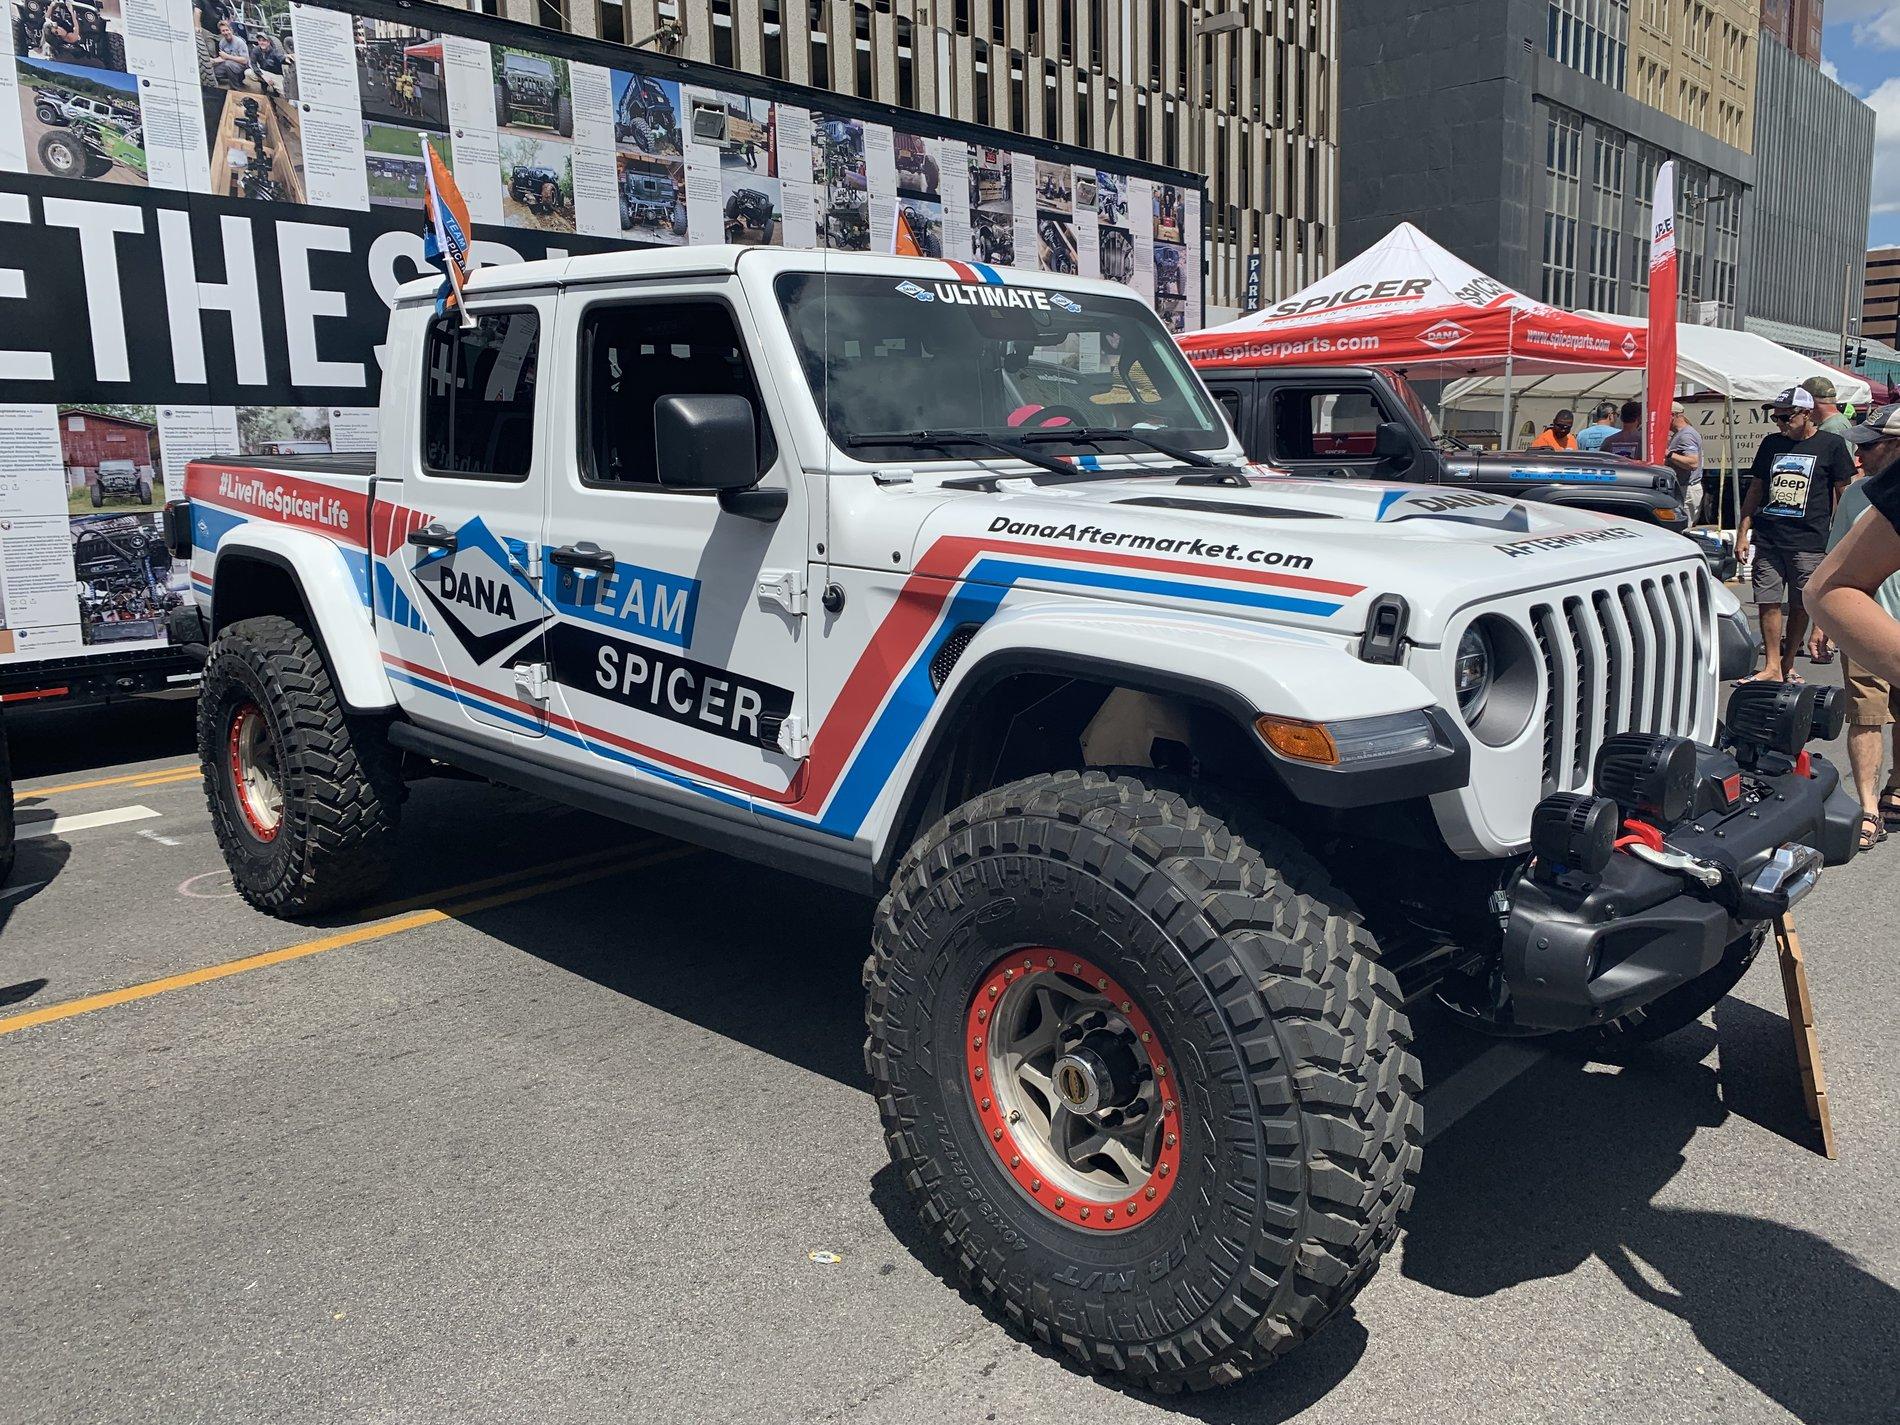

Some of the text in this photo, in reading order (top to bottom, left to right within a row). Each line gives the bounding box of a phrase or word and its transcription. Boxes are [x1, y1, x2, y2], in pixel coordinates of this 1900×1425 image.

[446, 217, 466, 247] TEAM
[934, 283, 1052, 310] ULTIMATE
[1247, 259, 1260, 310] PARK
[1269, 278, 1433, 319] SPICER
[1184, 334, 1380, 362] ww.spicerparts.com
[1427, 330, 1460, 341] DANA
[1527, 329, 1611, 351] www.spicerparts.com
[1700, 409, 1715, 426] Z
[1773, 475, 1806, 490] Jeep
[1774, 489, 1797, 502] fest
[218, 472, 349, 529] #LiveTheSpicerLife
[1406, 493, 1510, 513] DANA
[987, 515, 1314, 570] DanaAftermarket.com
[440, 565, 517, 621] DANA
[568, 566, 689, 635] TEAM
[595, 644, 764, 739] SPICER
[1051, 1264, 1136, 1294] M/T
